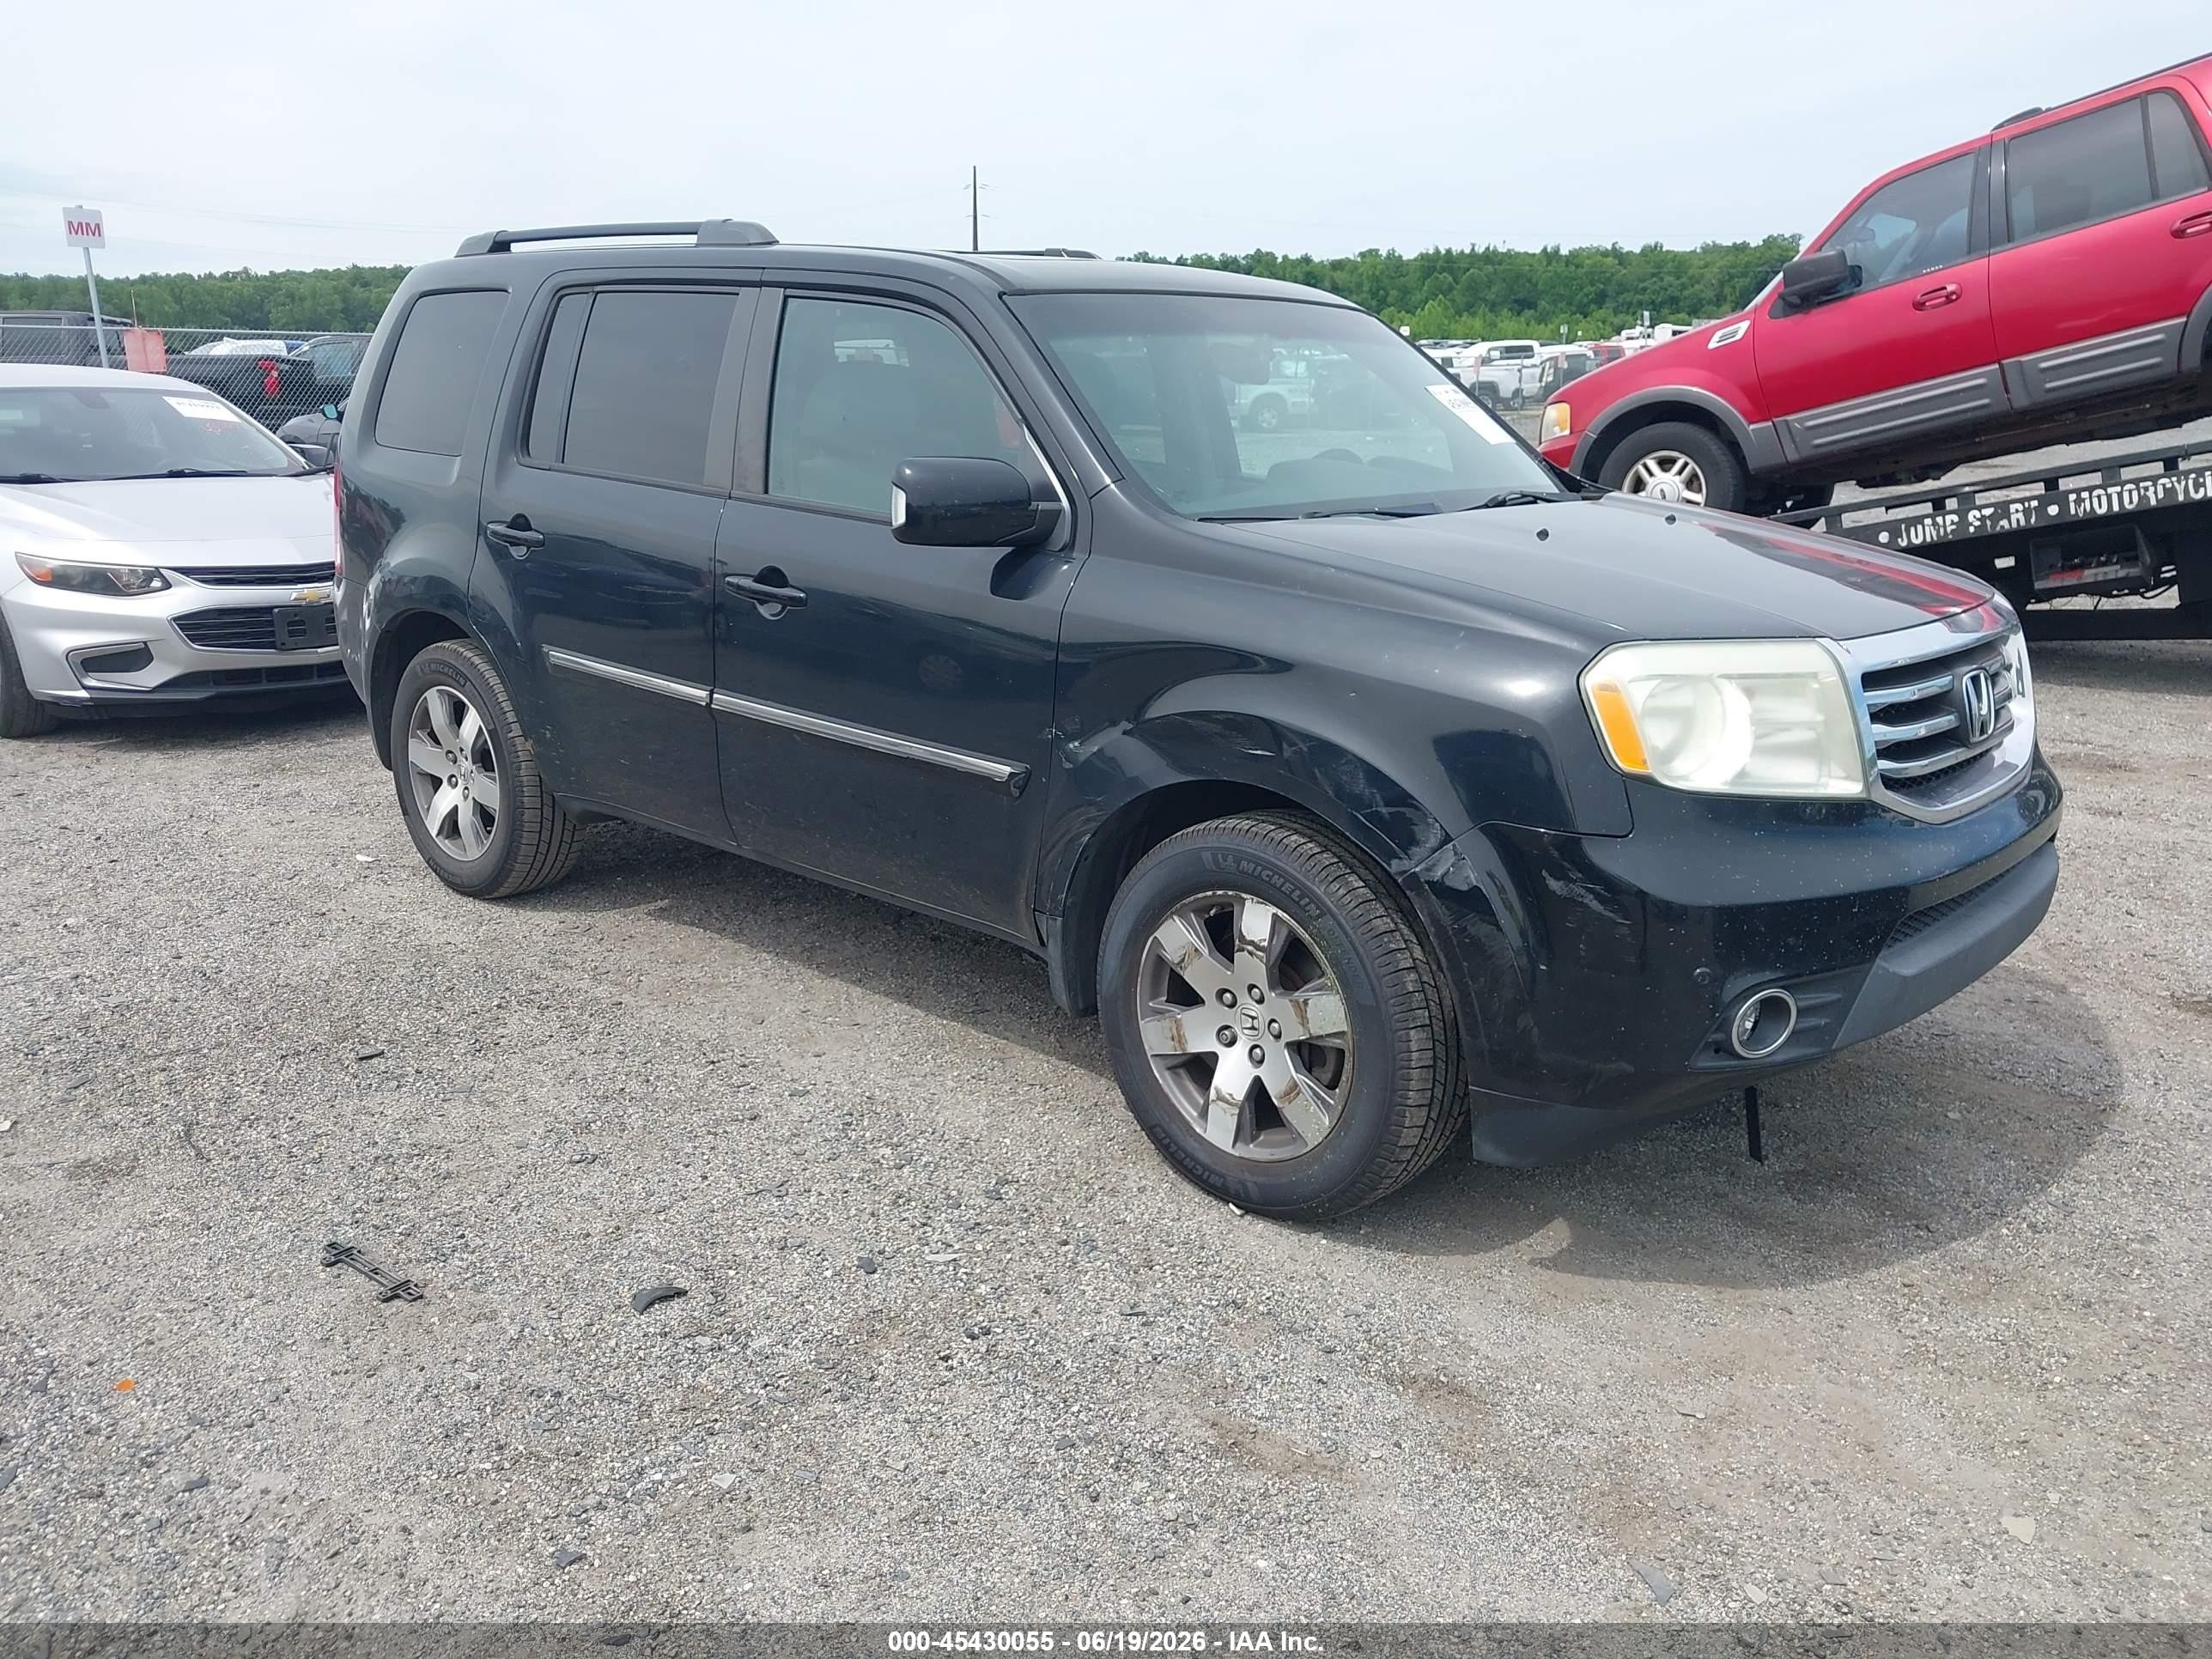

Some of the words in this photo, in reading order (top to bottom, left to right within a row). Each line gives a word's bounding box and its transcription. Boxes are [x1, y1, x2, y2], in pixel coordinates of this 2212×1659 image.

[68, 220, 101, 237] MM
[1897, 514, 1959, 547] JUMP
[1967, 500, 2039, 533] START
[1238, 860, 1322, 921] MICHELIN
